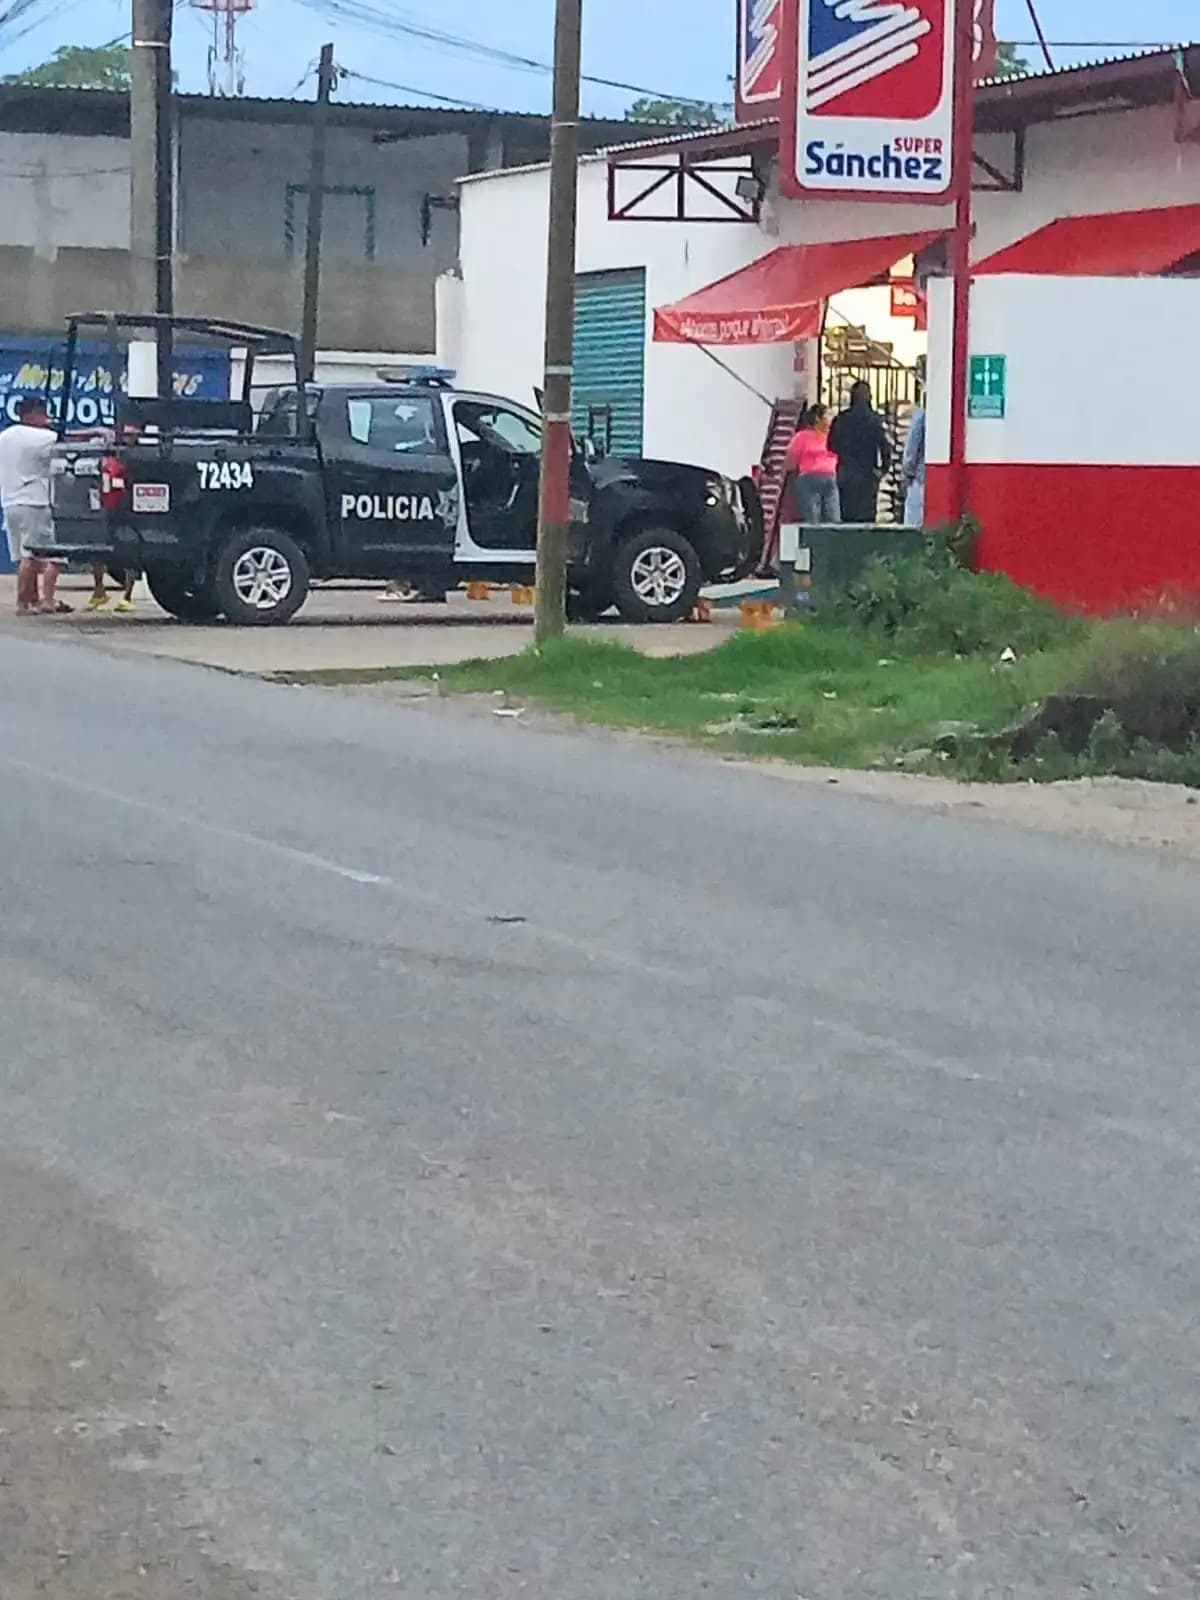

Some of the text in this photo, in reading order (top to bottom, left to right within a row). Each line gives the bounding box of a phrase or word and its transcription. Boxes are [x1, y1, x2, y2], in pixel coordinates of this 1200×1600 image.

[893, 137, 943, 154] SUPER
[805, 140, 943, 181] Sánchez
[196, 461, 254, 489] 72434
[341, 494, 434, 520] POLICIA
